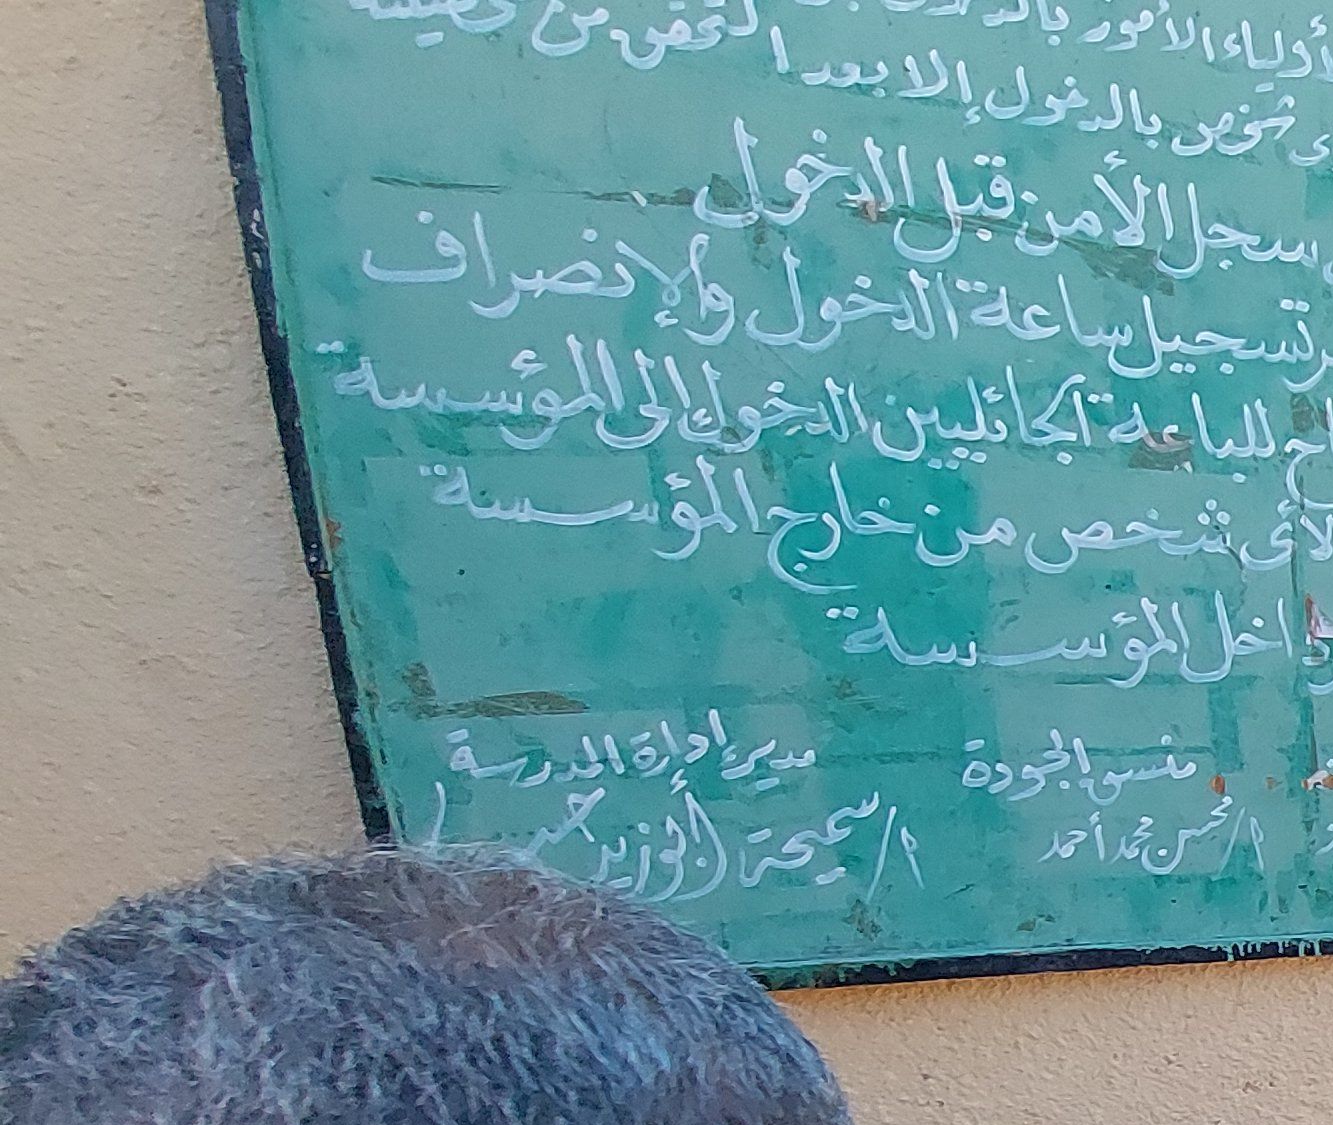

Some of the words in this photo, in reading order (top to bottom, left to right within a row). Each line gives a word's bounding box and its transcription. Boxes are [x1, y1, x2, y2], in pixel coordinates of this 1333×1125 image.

[800, 60, 890, 99] بعد
[897, 49, 981, 126] إلا
[984, 65, 1163, 149] بالدخول
[1171, 95, 1297, 157] شخص
[691, 116, 915, 227] الدخول
[893, 154, 1015, 263] قبل
[1015, 151, 1174, 256] الأمن
[1152, 182, 1319, 279] سجل
[744, 245, 959, 350] الدخول
[955, 274, 1133, 347] ساعة
[1108, 294, 1315, 380] تسجيل
[315, 334, 625, 451] المؤسسة
[597, 348, 713, 449] إلى
[678, 360, 868, 453] الدخول
[1087, 391, 1277, 483] للباعة
[419, 454, 761, 562] المؤسسة
[767, 460, 916, 594] خارج
[915, 504, 1018, 567] من
[1024, 499, 1231, 574] شخص
[825, 597, 1189, 688] المؤسسة
[446, 728, 626, 788] المدرسة
[721, 739, 816, 791] مدير
[962, 728, 1092, 801] الجودة
[1037, 811, 1105, 863] أحمد
[1109, 816, 1153, 864] محمد
